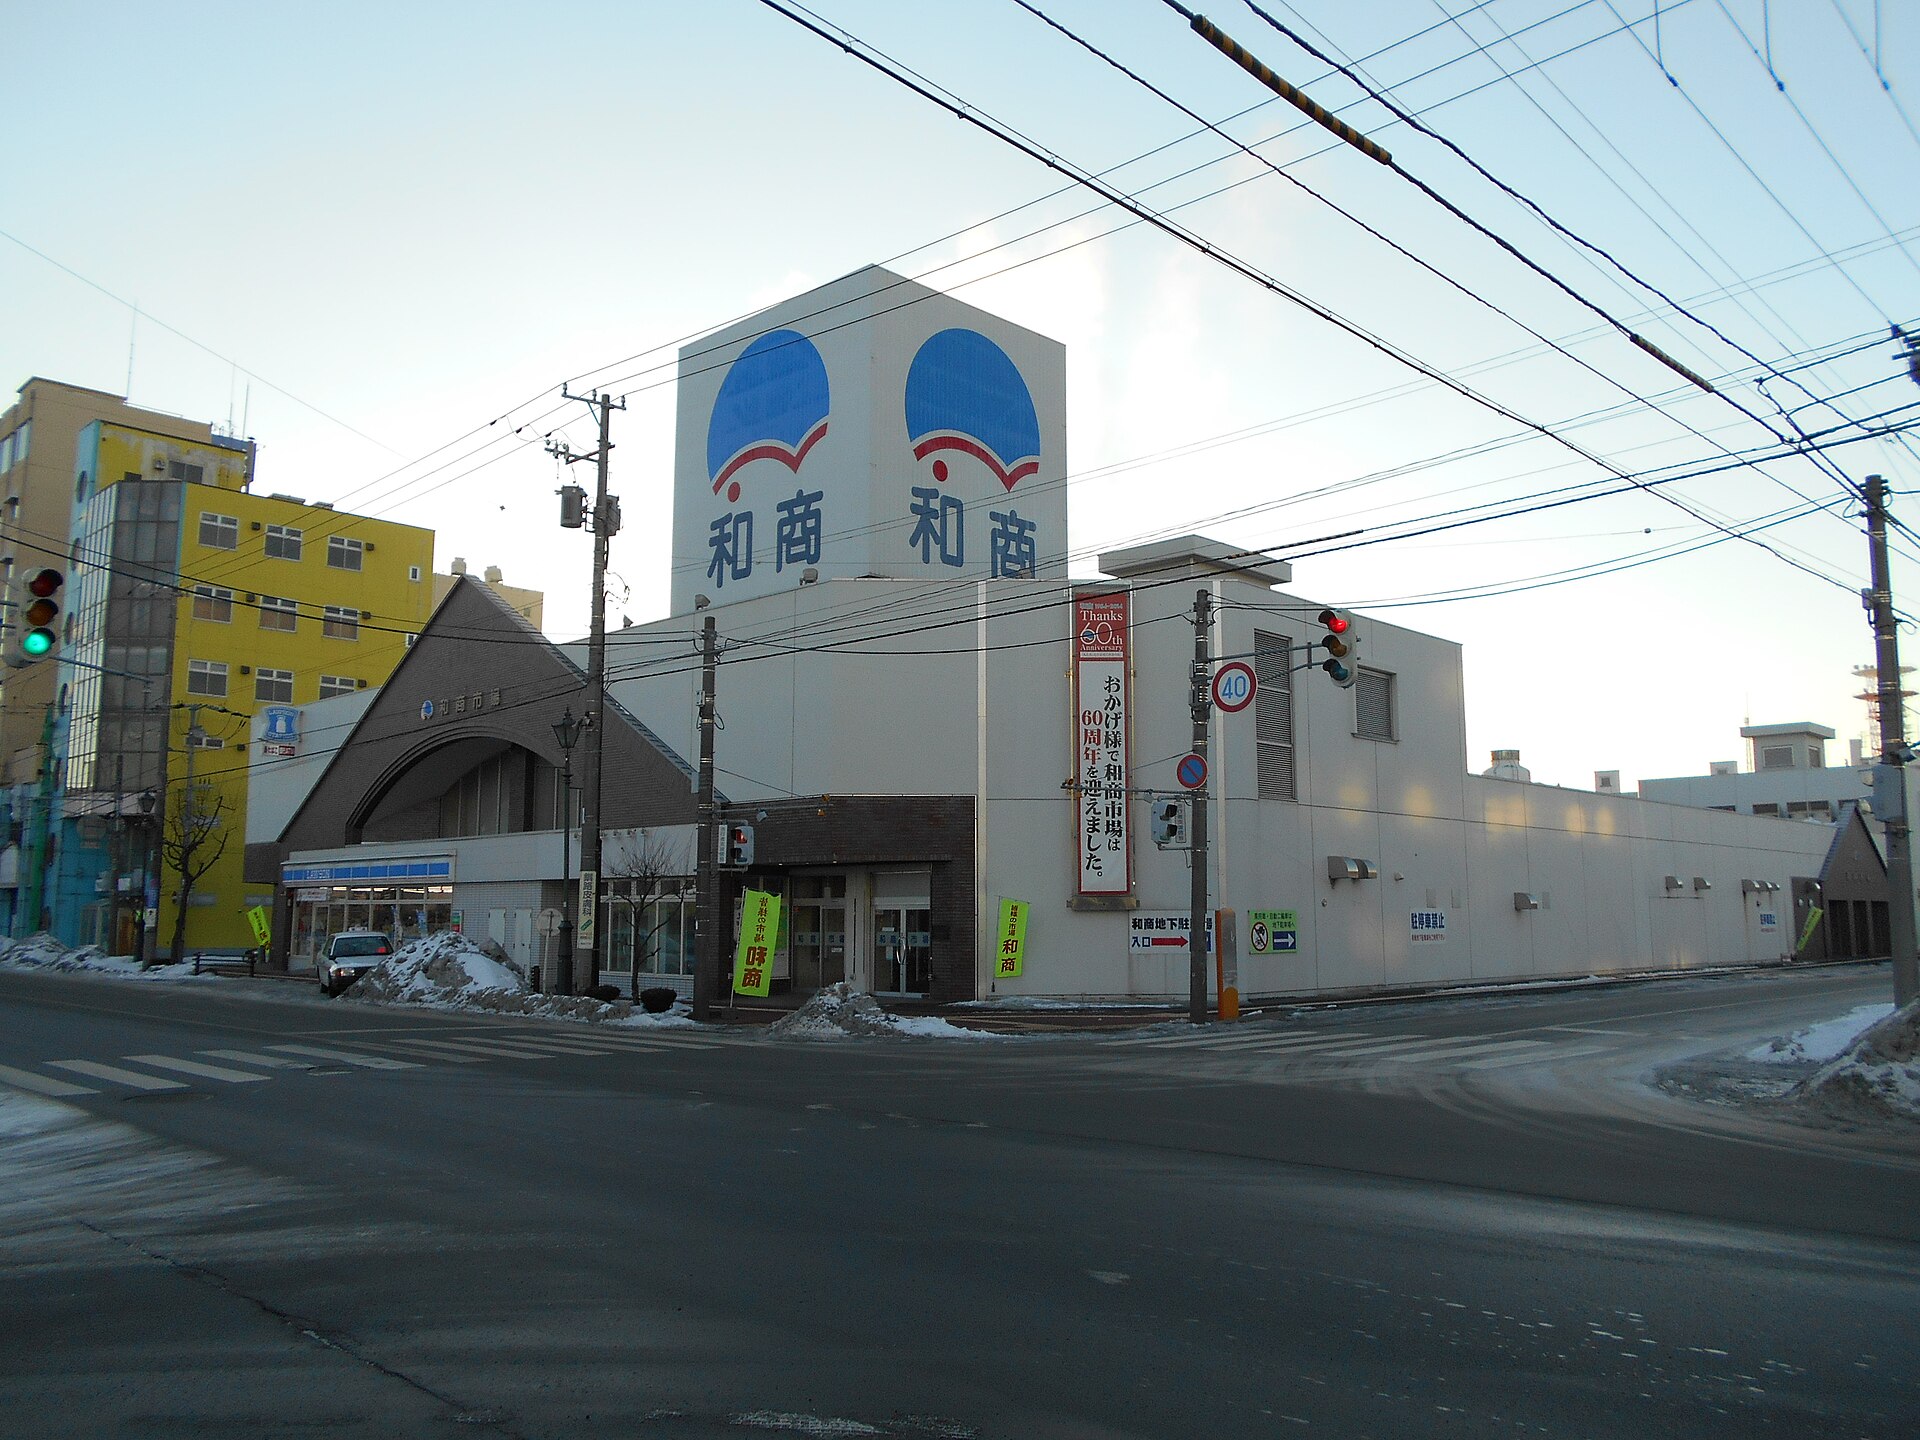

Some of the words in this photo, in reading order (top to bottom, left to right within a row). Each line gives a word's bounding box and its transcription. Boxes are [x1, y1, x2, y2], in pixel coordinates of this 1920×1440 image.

[707, 488, 823, 588] 和商
[909, 486, 1036, 580] 和商
[1080, 610, 1123, 621] Thanks
[1080, 644, 1123, 652] Anniversary
[1222, 675, 1247, 699] 40
[439, 687, 501, 716] 和商市場
[1103, 675, 1123, 851] おかげ様で和商市場は
[1081, 709, 1103, 877] 60周年を迎えました。
[306, 869, 331, 880] LAWSON
[1132, 917, 1213, 931] 和商地下駐場
[1411, 912, 1445, 929] 駐停車禁止
[1132, 936, 1151, 947] 入口
[1001, 939, 1019, 973] 和商
